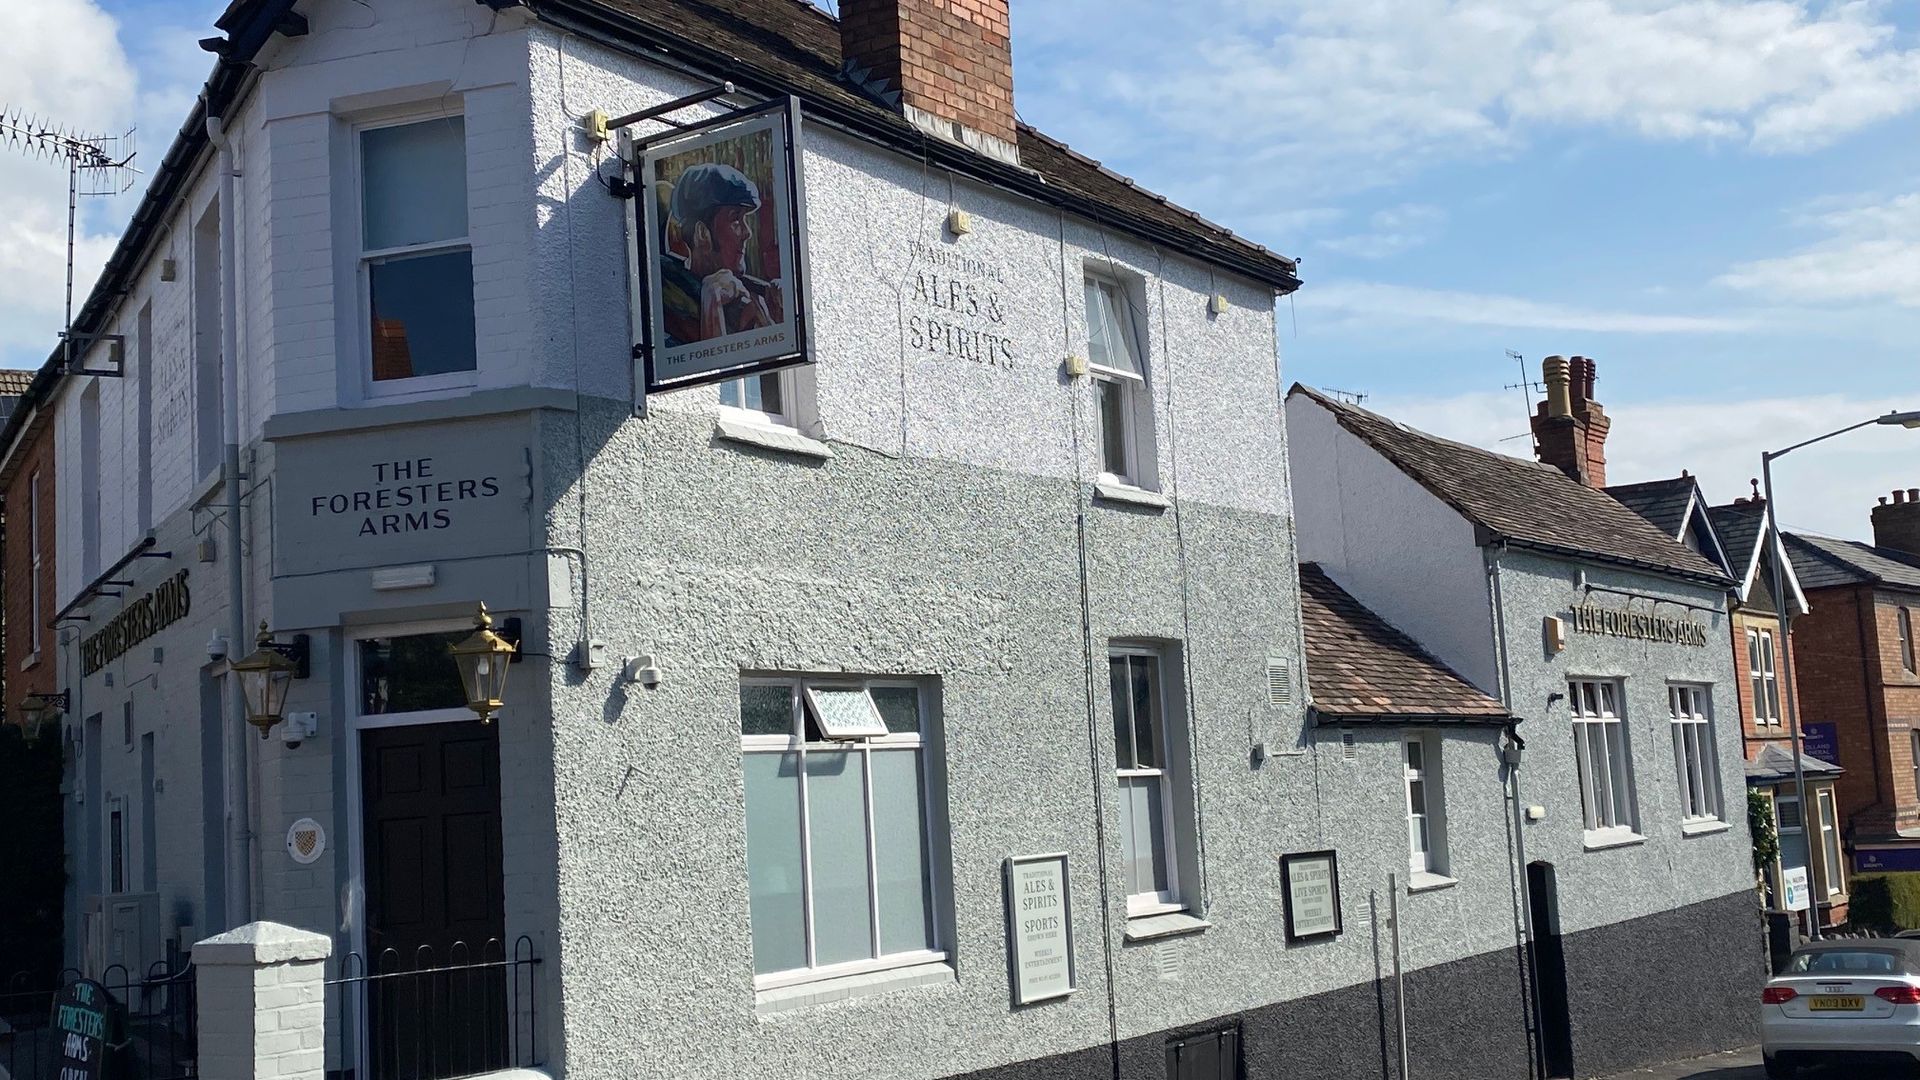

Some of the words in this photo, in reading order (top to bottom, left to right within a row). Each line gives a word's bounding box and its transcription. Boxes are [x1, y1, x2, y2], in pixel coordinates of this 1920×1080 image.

[912, 270, 978, 317] ALES
[989, 291, 1006, 325] &
[667, 353, 686, 365] THE
[689, 341, 750, 361] FORESTERS
[754, 333, 785, 347] ARMS
[910, 315, 1013, 371] SPIRITS
[371, 457, 433, 482] THE
[312, 477, 499, 516] FORESTERS
[358, 508, 451, 537] ARMS
[99, 593, 154, 669] FORESTERS
[153, 568, 190, 632] ARMS
[1570, 603, 1601, 635] THE
[1602, 608, 1676, 643] FORESTERS
[1676, 619, 1707, 647] ARMS
[1024, 879, 1046, 894] ALES
[1048, 879, 1055, 891] &
[1023, 894, 1057, 911] SPIRITS
[1024, 916, 1058, 933] SPORTS
[75, 982, 93, 1006] THE
[58, 1004, 103, 1040] FORESTERS
[65, 1032, 89, 1062] ARMS
